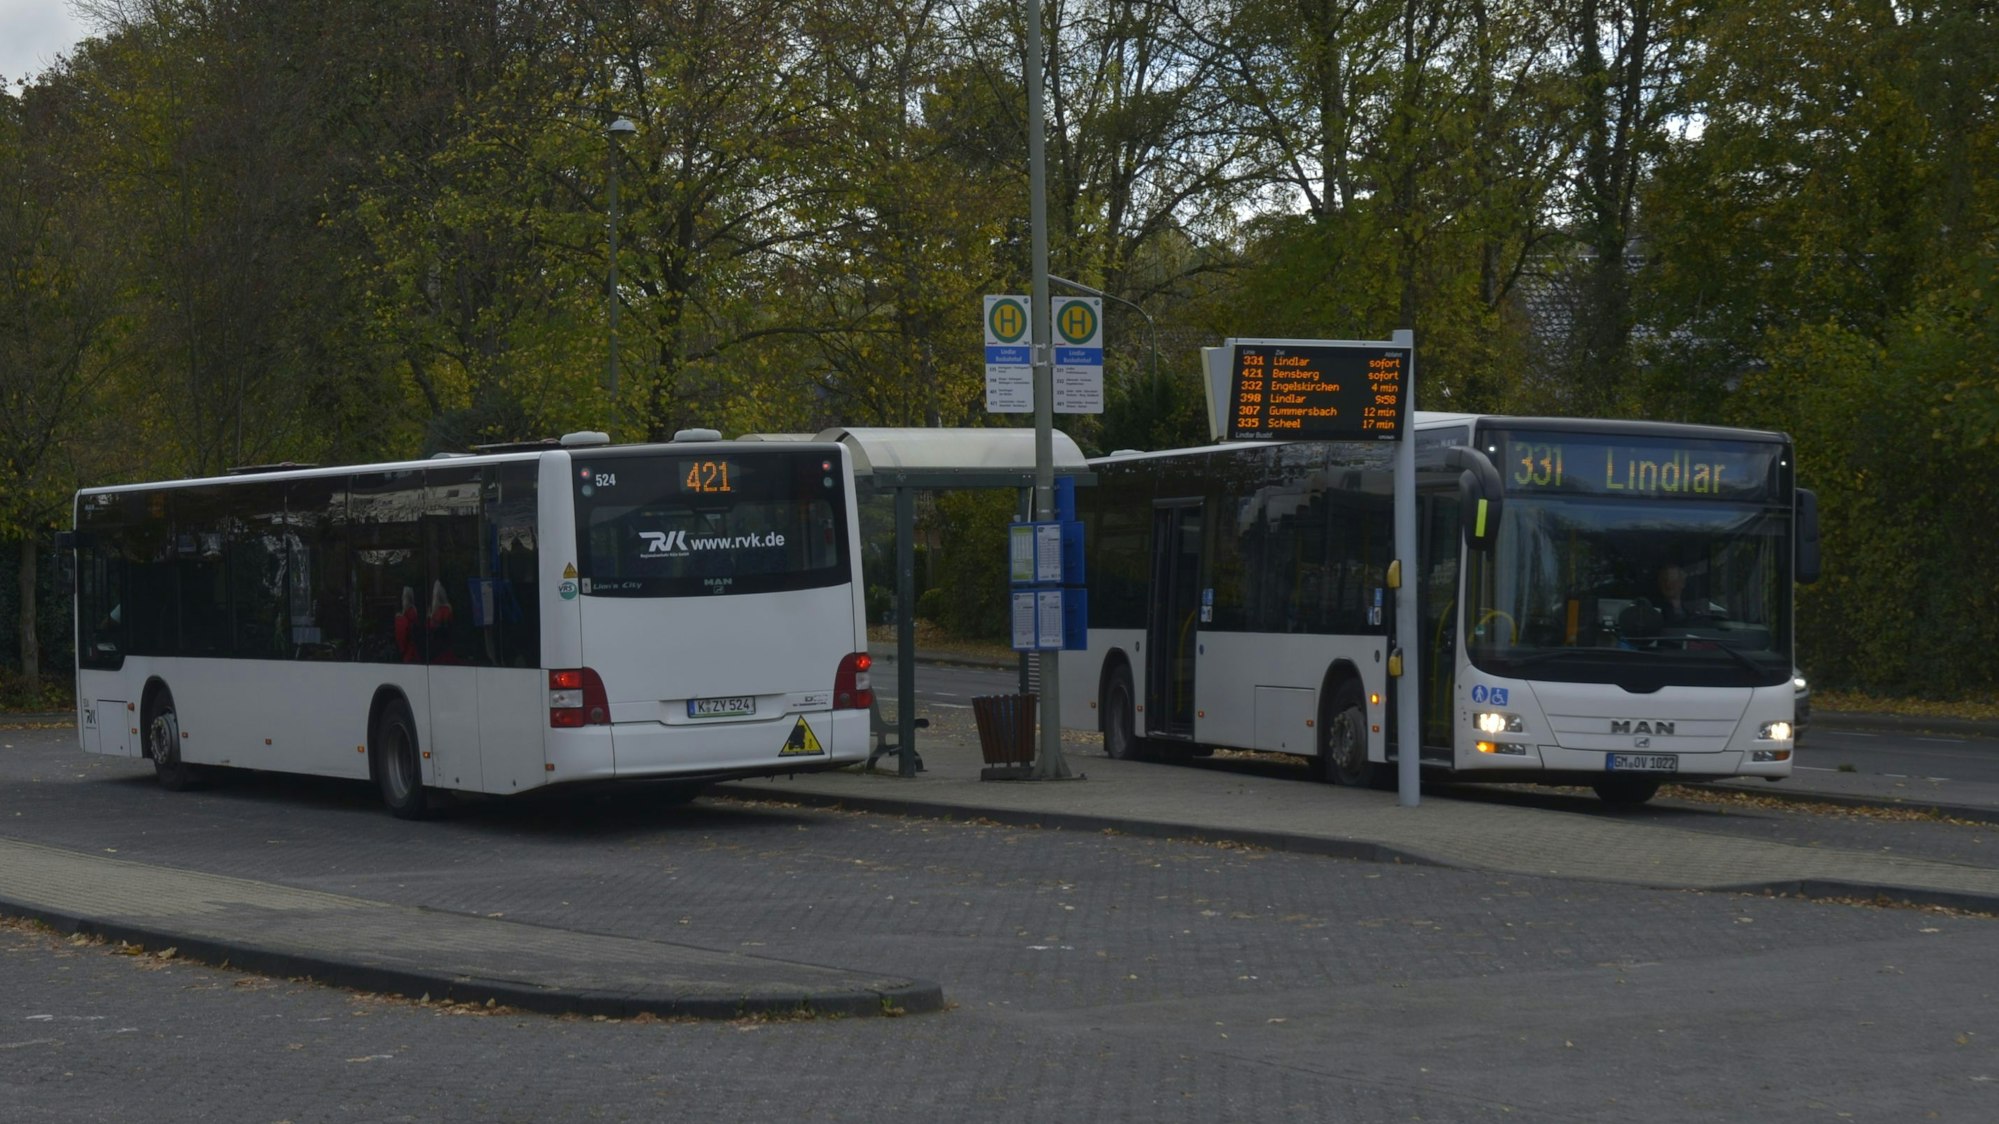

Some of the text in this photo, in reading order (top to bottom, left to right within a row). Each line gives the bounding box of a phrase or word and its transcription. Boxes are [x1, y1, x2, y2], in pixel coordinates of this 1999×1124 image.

[1243, 356, 1400, 369] 331 Lindlar sofort
[1242, 369, 1399, 381] 421 Bensberg sofort
[1241, 382, 1398, 392] 332 Engelskirchen 4 min
[1240, 394, 1262, 403] 398
[1270, 394, 1307, 404] Lindlar
[1238, 406, 1396, 417] 307 Gummersbach 12 min
[1237, 418, 1395, 429] 335 Scheel 17 min
[1514, 443, 1726, 494] 331 Lindlar
[595, 473, 616, 487] 524
[686, 461, 731, 492] 421
[638, 530, 785, 552] RVK www.rvk.de
[704, 577, 733, 586] MAN
[698, 698, 750, 713] K ZY 524
[1611, 720, 1675, 735] MAN
[1615, 756, 1675, 769] GM OV 1022
